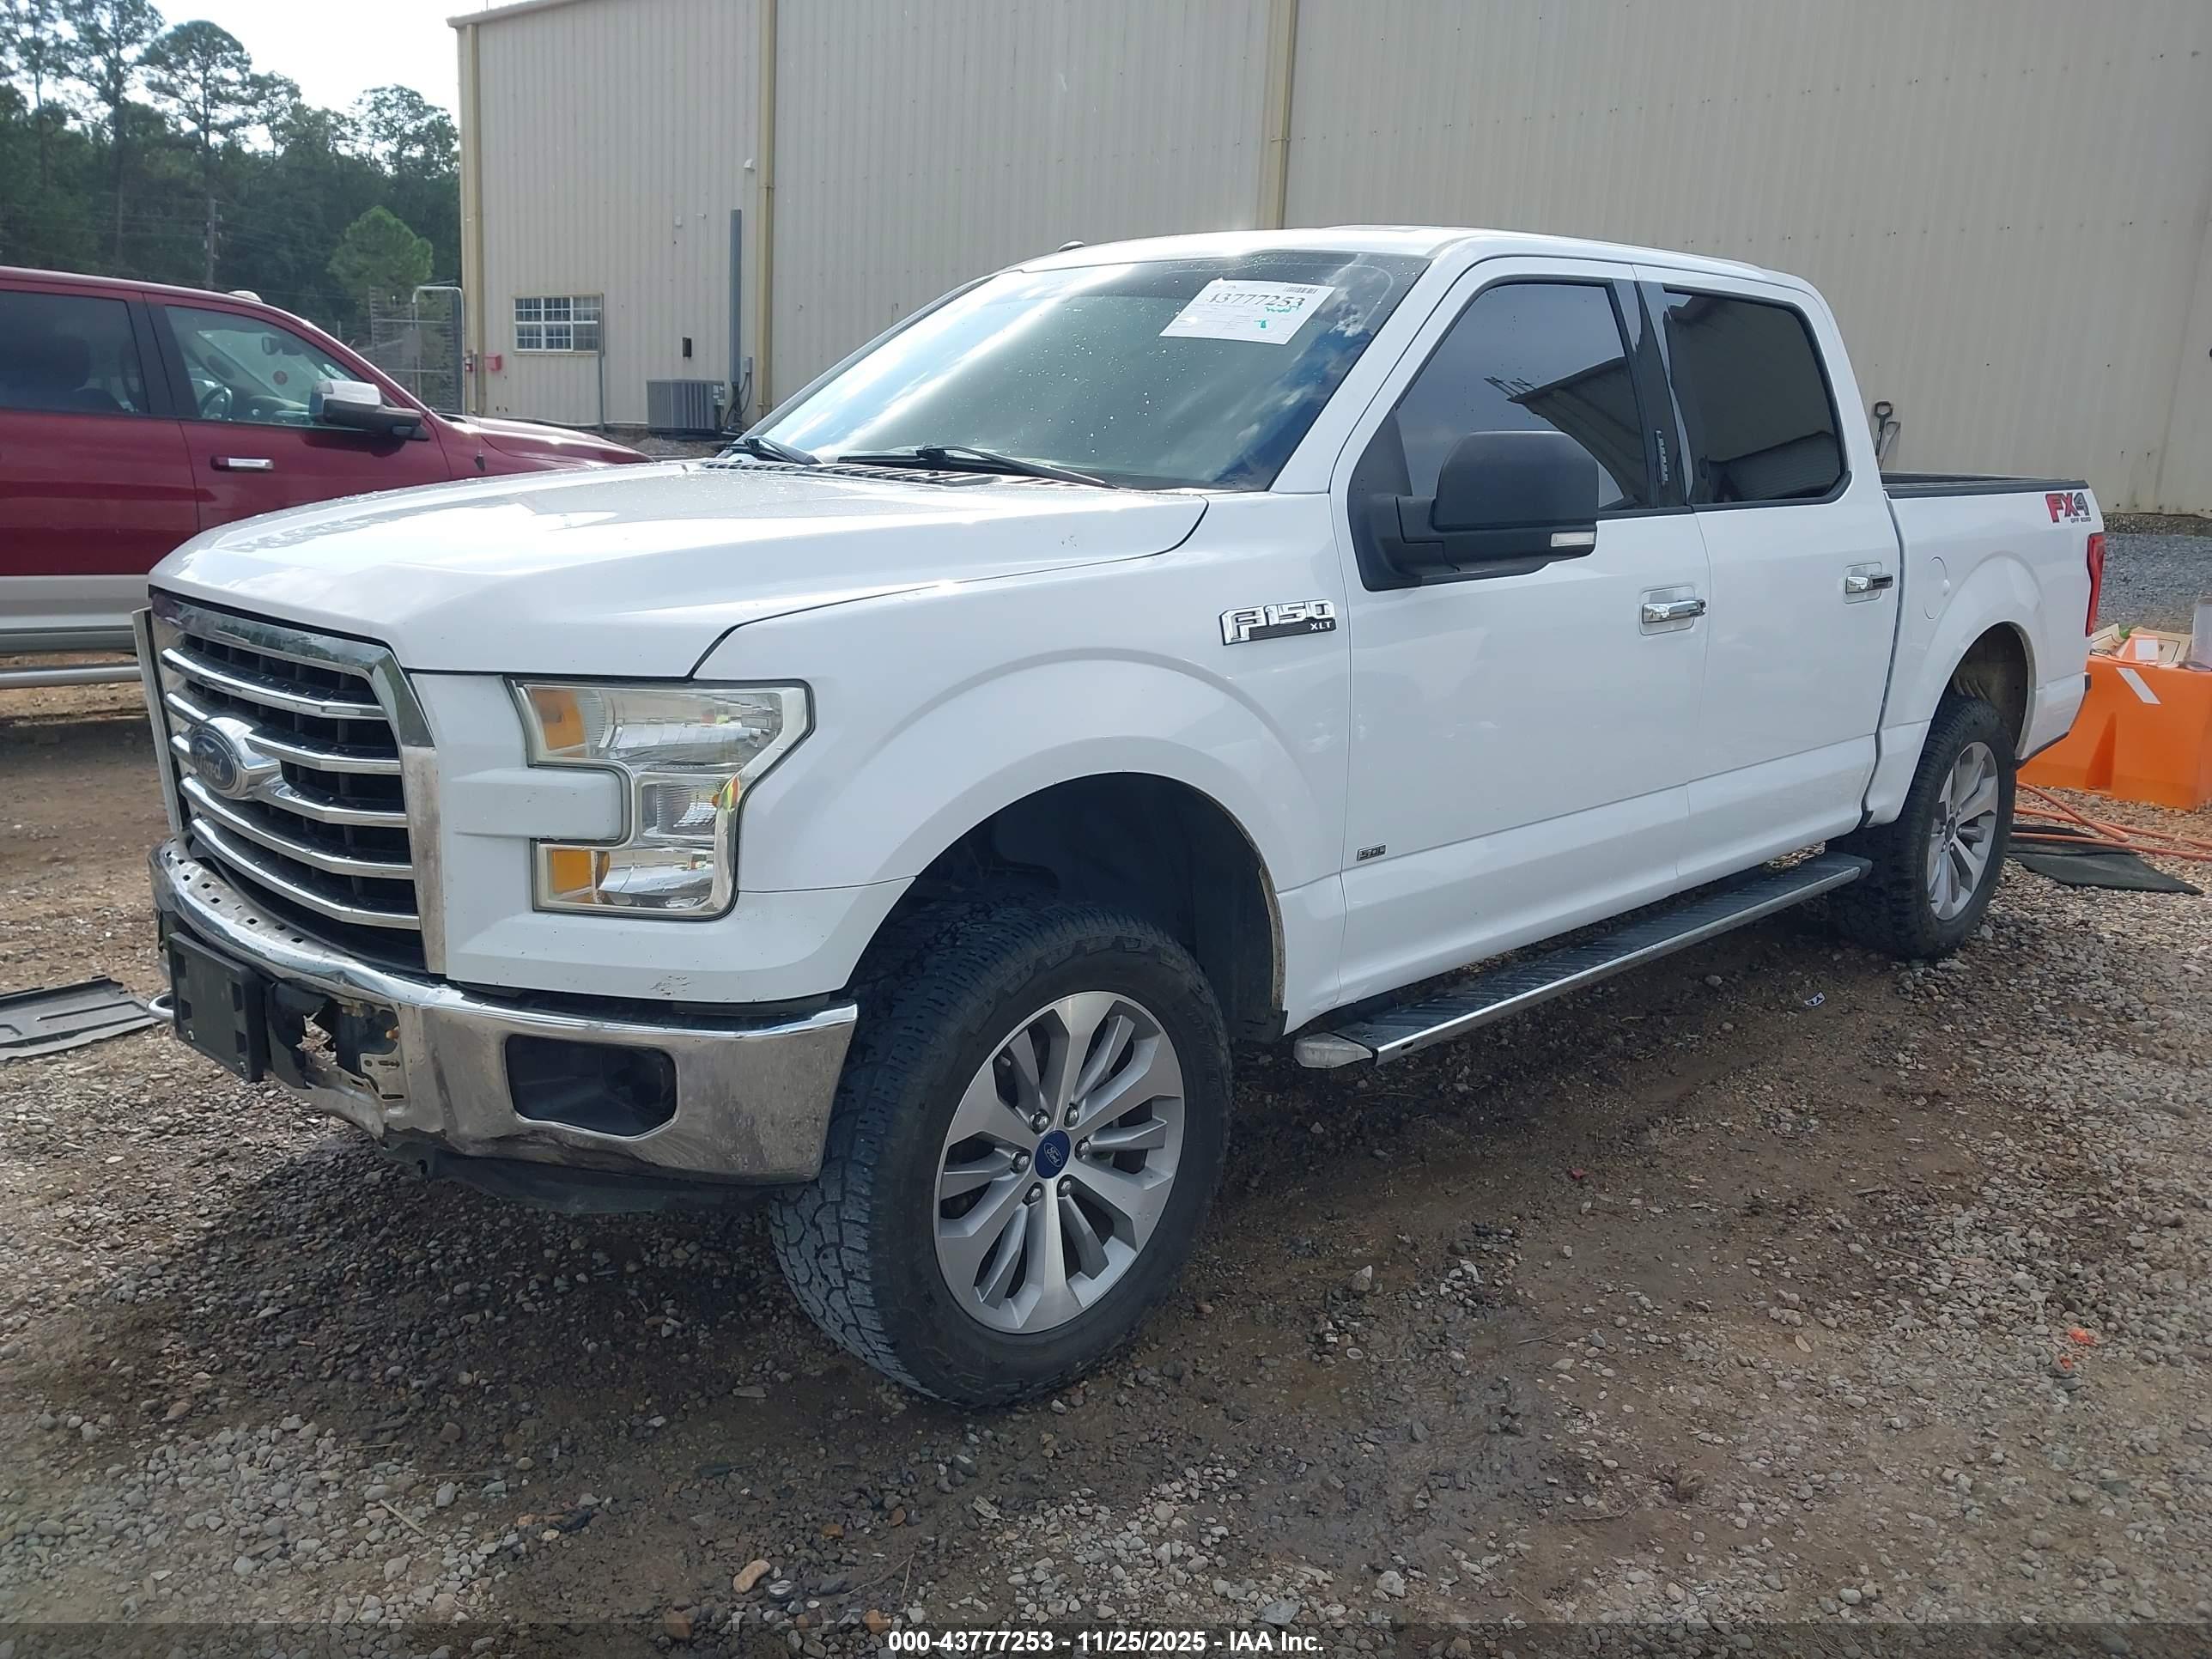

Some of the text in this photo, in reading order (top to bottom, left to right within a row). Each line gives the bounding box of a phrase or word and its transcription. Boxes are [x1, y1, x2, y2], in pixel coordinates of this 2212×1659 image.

[2045, 492, 2090, 523] FX4
[1310, 622, 1333, 630] XLT
[195, 740, 224, 781] Ford
[1047, 1147, 1060, 1164] Ford
